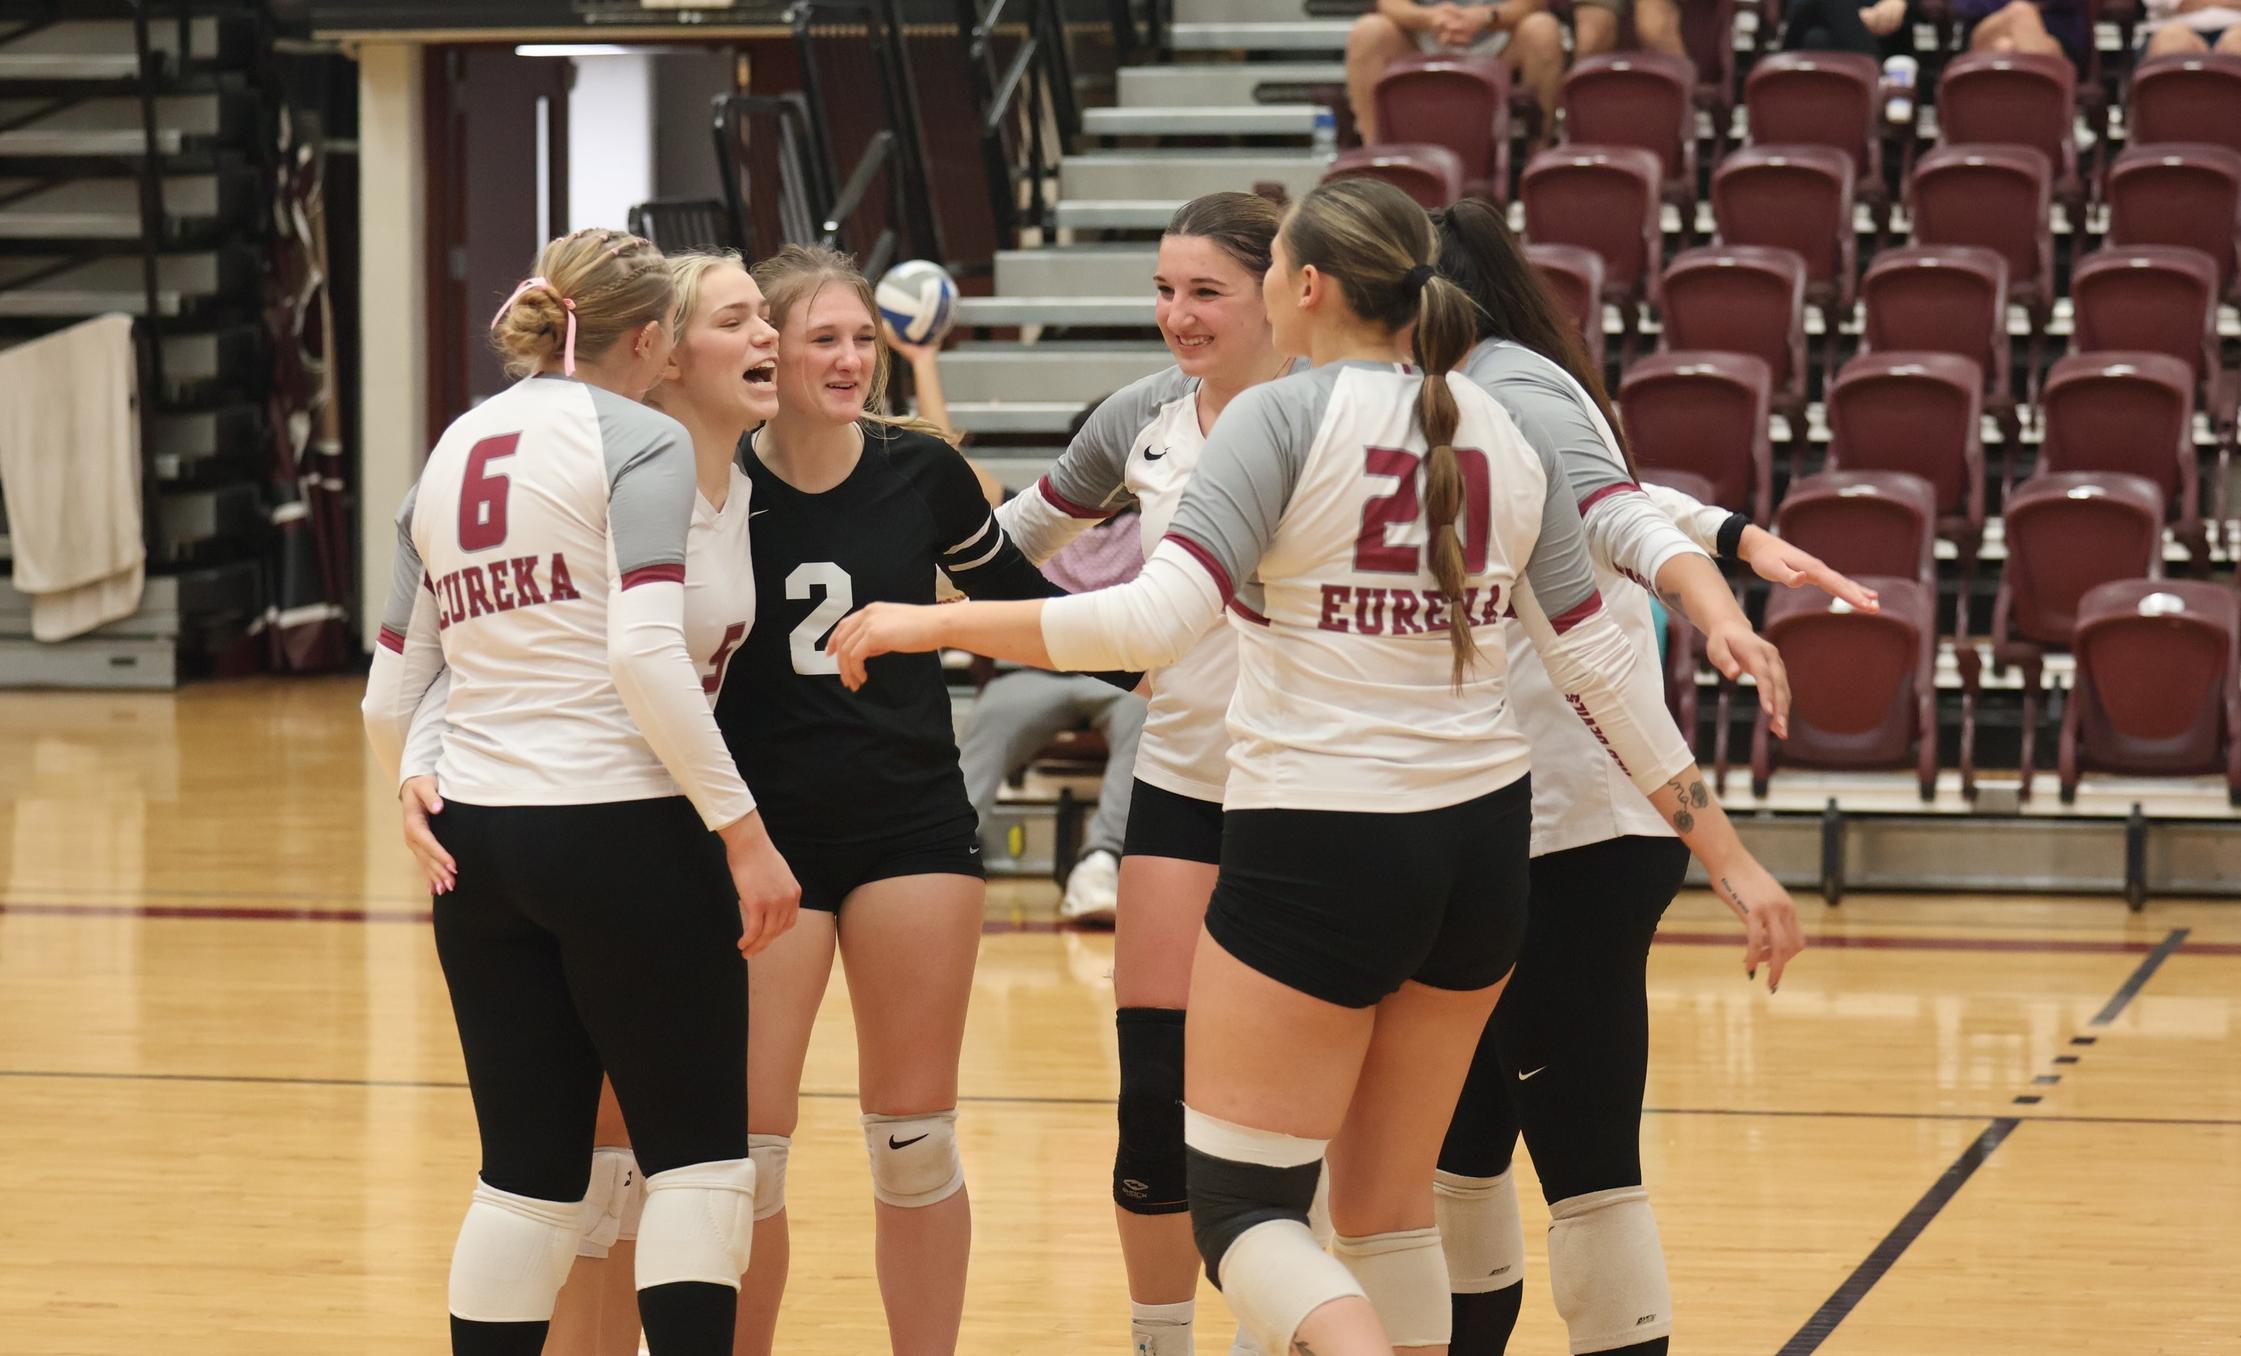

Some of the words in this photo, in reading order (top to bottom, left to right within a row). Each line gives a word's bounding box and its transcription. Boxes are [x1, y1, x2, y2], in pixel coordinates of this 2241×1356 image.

[457, 430, 523, 554] 6
[1352, 445, 1491, 576] 20
[435, 552, 581, 631] EUREKA
[785, 561, 853, 675] 2
